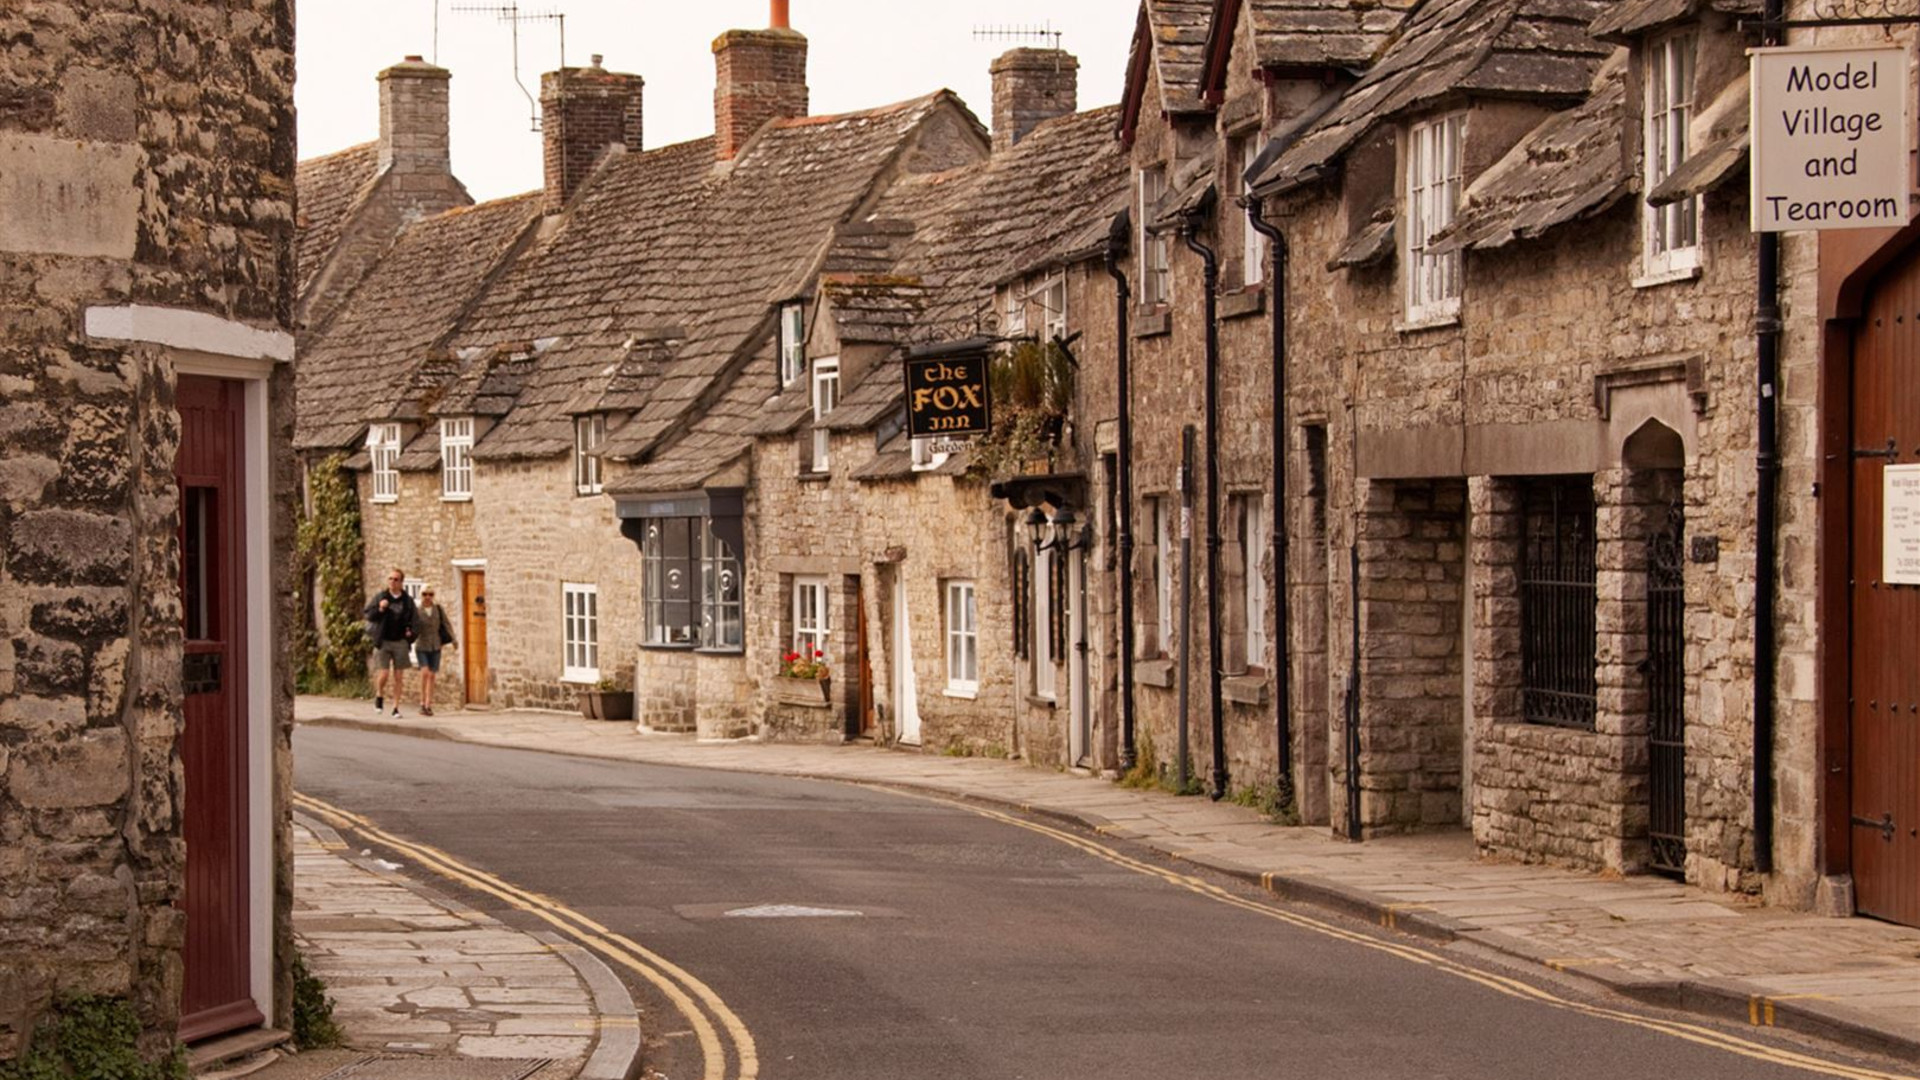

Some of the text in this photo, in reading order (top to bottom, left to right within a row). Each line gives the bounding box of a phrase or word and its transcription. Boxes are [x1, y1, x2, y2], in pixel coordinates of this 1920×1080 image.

[1786, 61, 1877, 92] Model
[1782, 107, 1882, 141] Village
[1804, 148, 1857, 177] and
[1766, 196, 1897, 221] Tearoom
[912, 384, 982, 412] FOX
[928, 440, 973, 454] Garden
